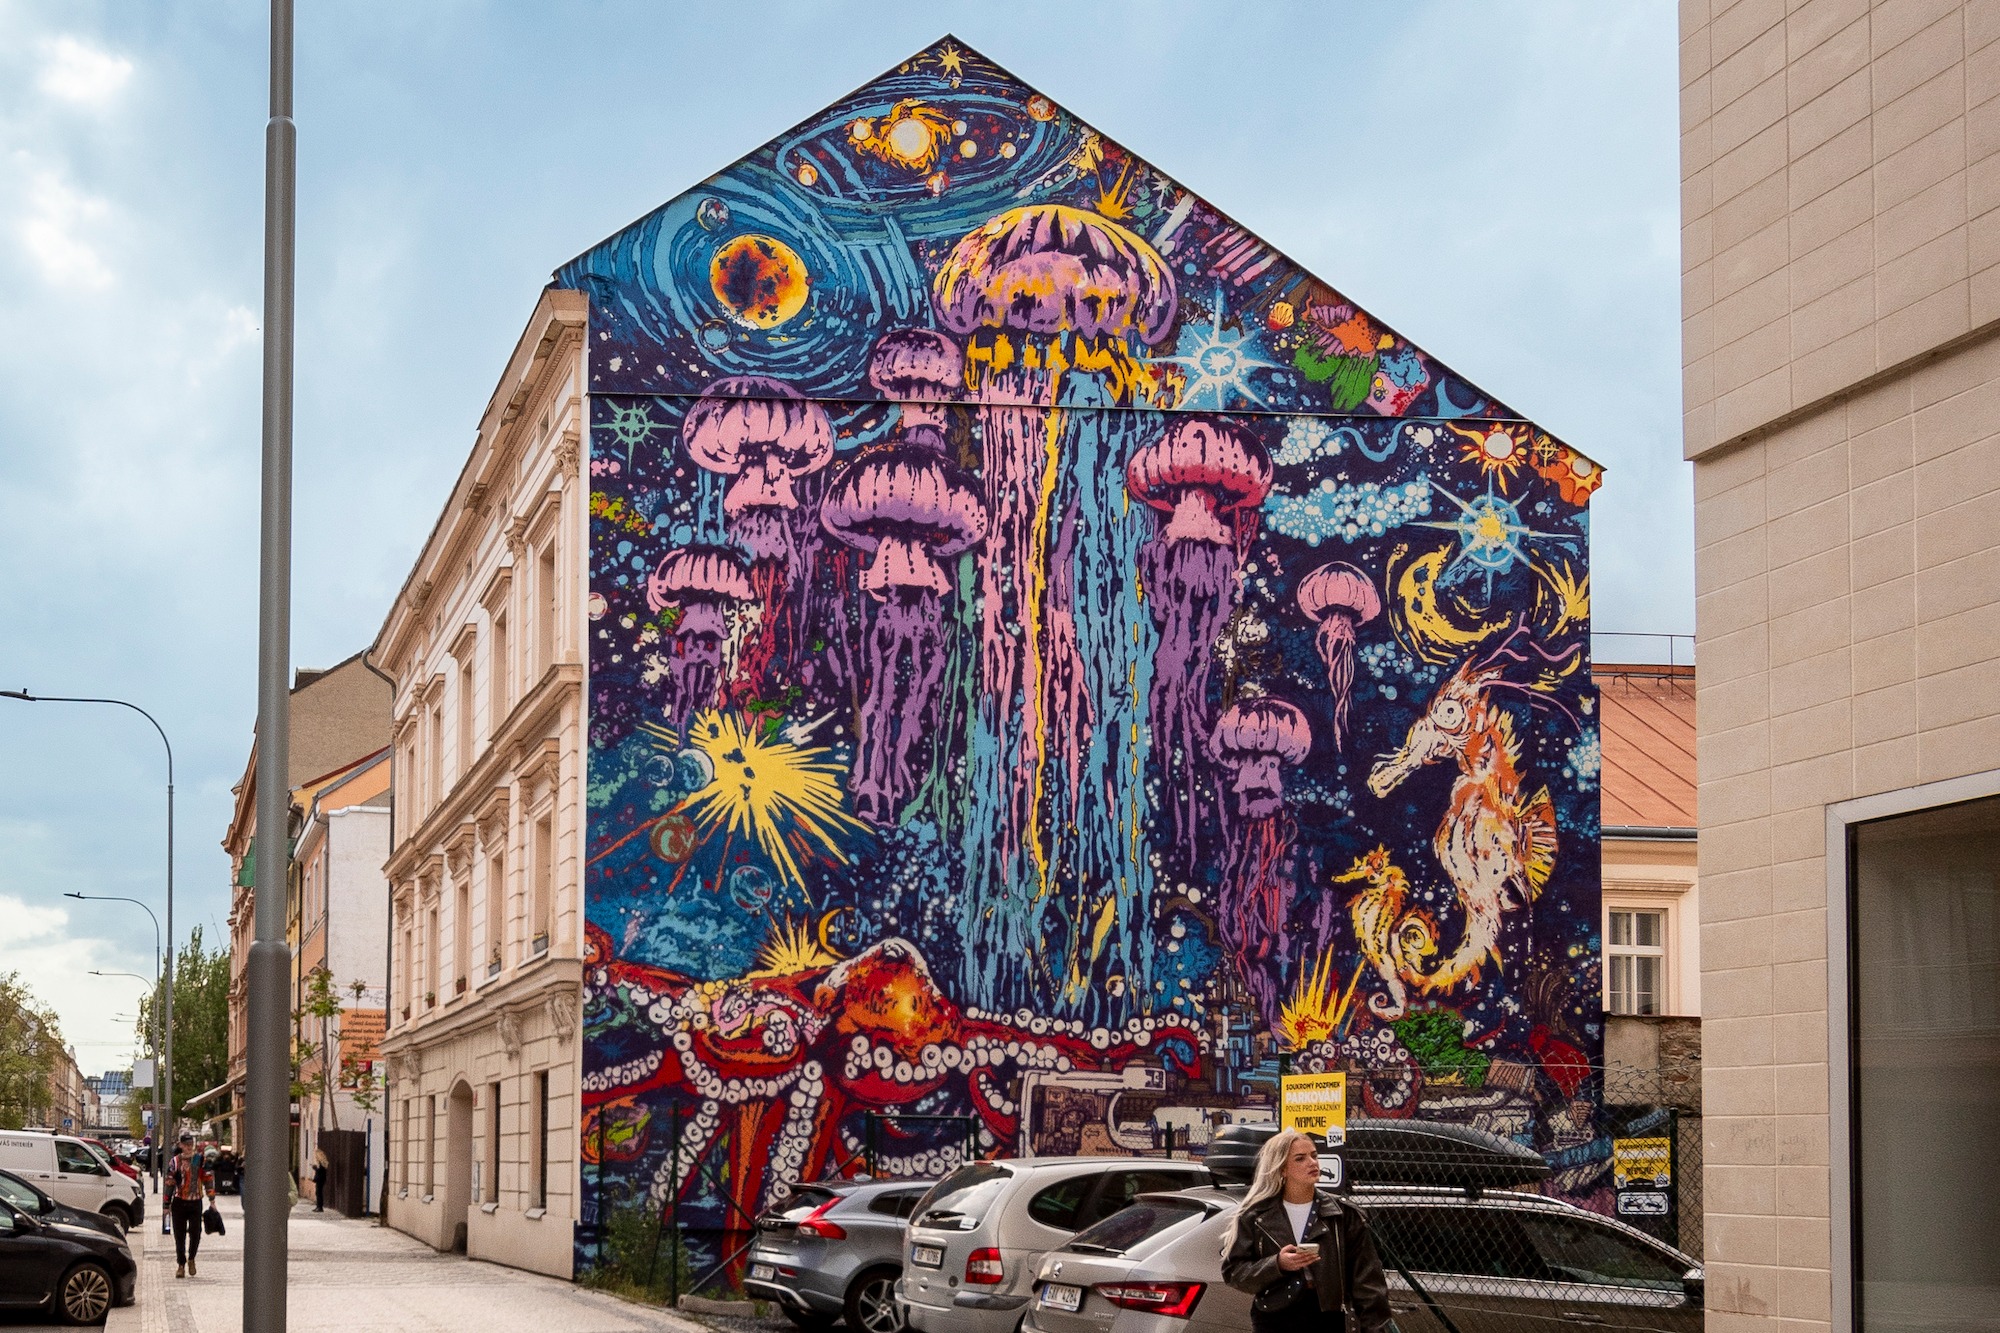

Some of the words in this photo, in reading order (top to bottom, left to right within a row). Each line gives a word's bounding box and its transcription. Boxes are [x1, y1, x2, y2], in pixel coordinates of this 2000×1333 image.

[1286, 1081, 1315, 1090] SOUKROMÝ
[1315, 1081, 1341, 1089] POZEMEK
[1285, 1087, 1342, 1104] PARKOVÁNÍ
[1286, 1104, 1302, 1112] POUZE
[1302, 1104, 1313, 1112] PRO
[1313, 1102, 1341, 1111] ZÁKAZNÍKY
[1328, 1135, 1343, 1144] 30M
